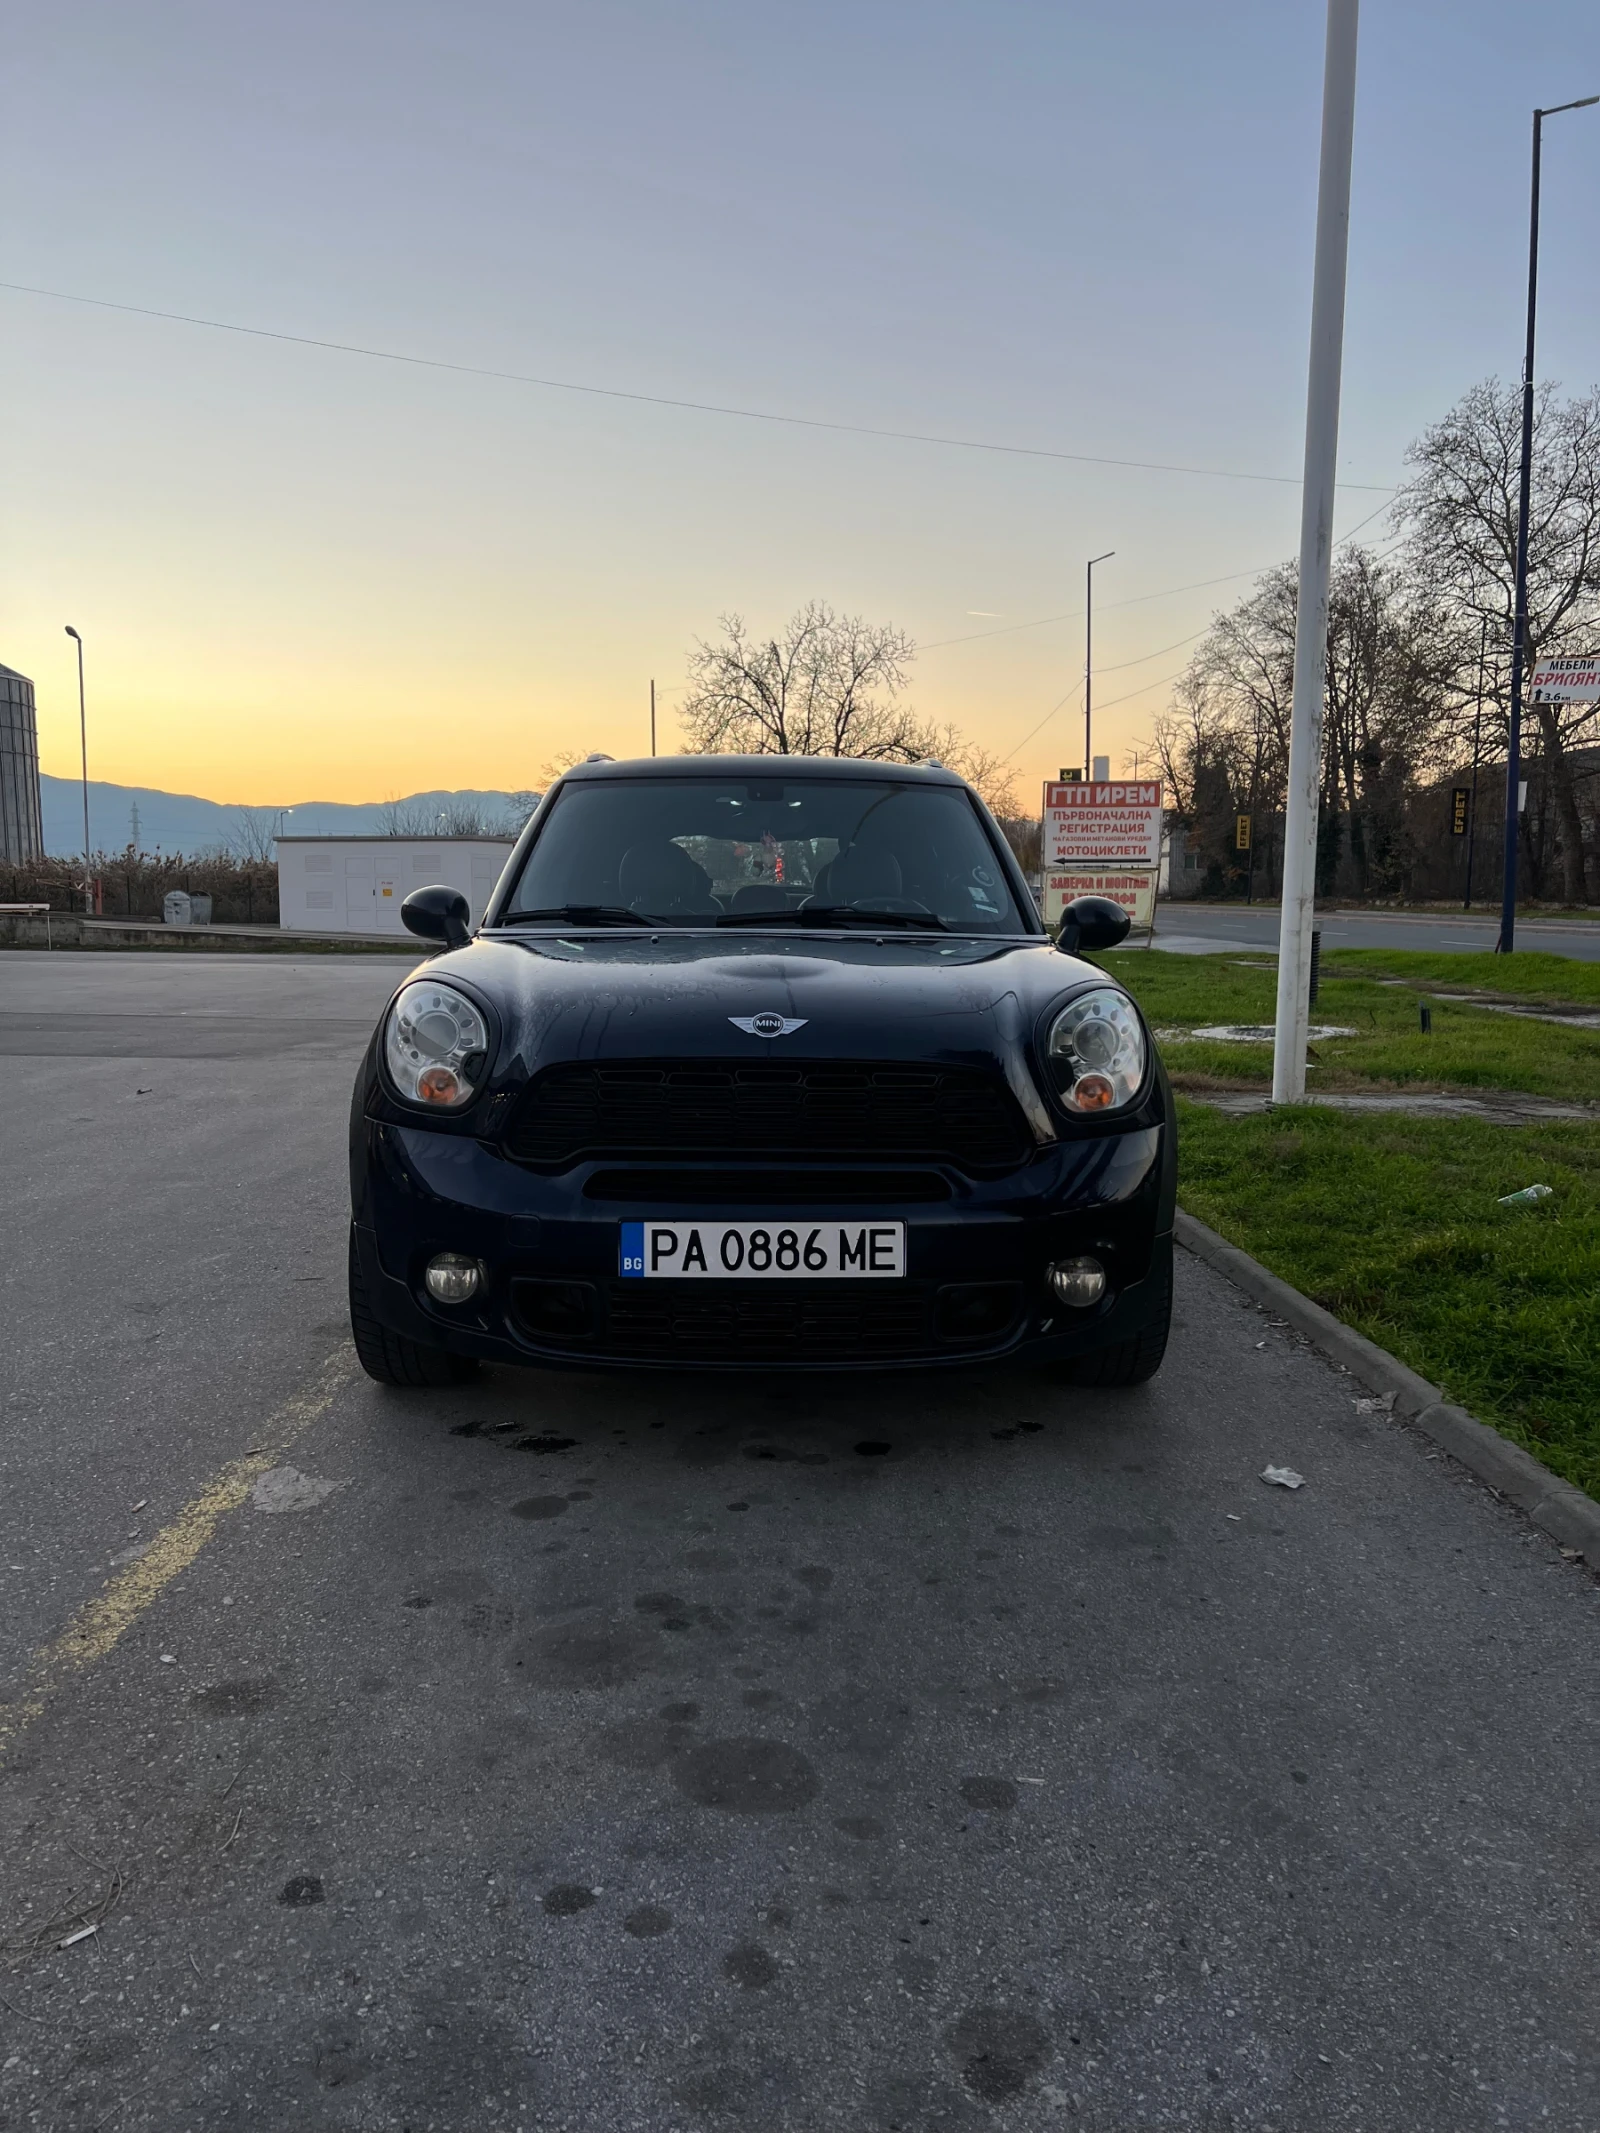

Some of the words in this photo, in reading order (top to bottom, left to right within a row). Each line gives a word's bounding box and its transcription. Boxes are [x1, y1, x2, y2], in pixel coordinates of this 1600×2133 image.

[1549, 660, 1595, 671] МЕБЕЛИ
[1544, 693, 1561, 701] 3.6
[1051, 786, 1091, 804] ГТП
[1095, 786, 1155, 804] ИРЕМ
[1053, 811, 1152, 820] ПЪРВОНАЧАЛНА
[1454, 791, 1466, 833] EFBET
[1059, 823, 1145, 833] РЕГИСТРАЦИЯ
[1057, 846, 1147, 856] МОТОЦИКЛЕТИ
[755, 1019, 781, 1027] MINI
[651, 1229, 708, 1271] PA
[720, 1229, 827, 1271] 0886
[839, 1228, 896, 1271] ME
[623, 1257, 642, 1270] BG
